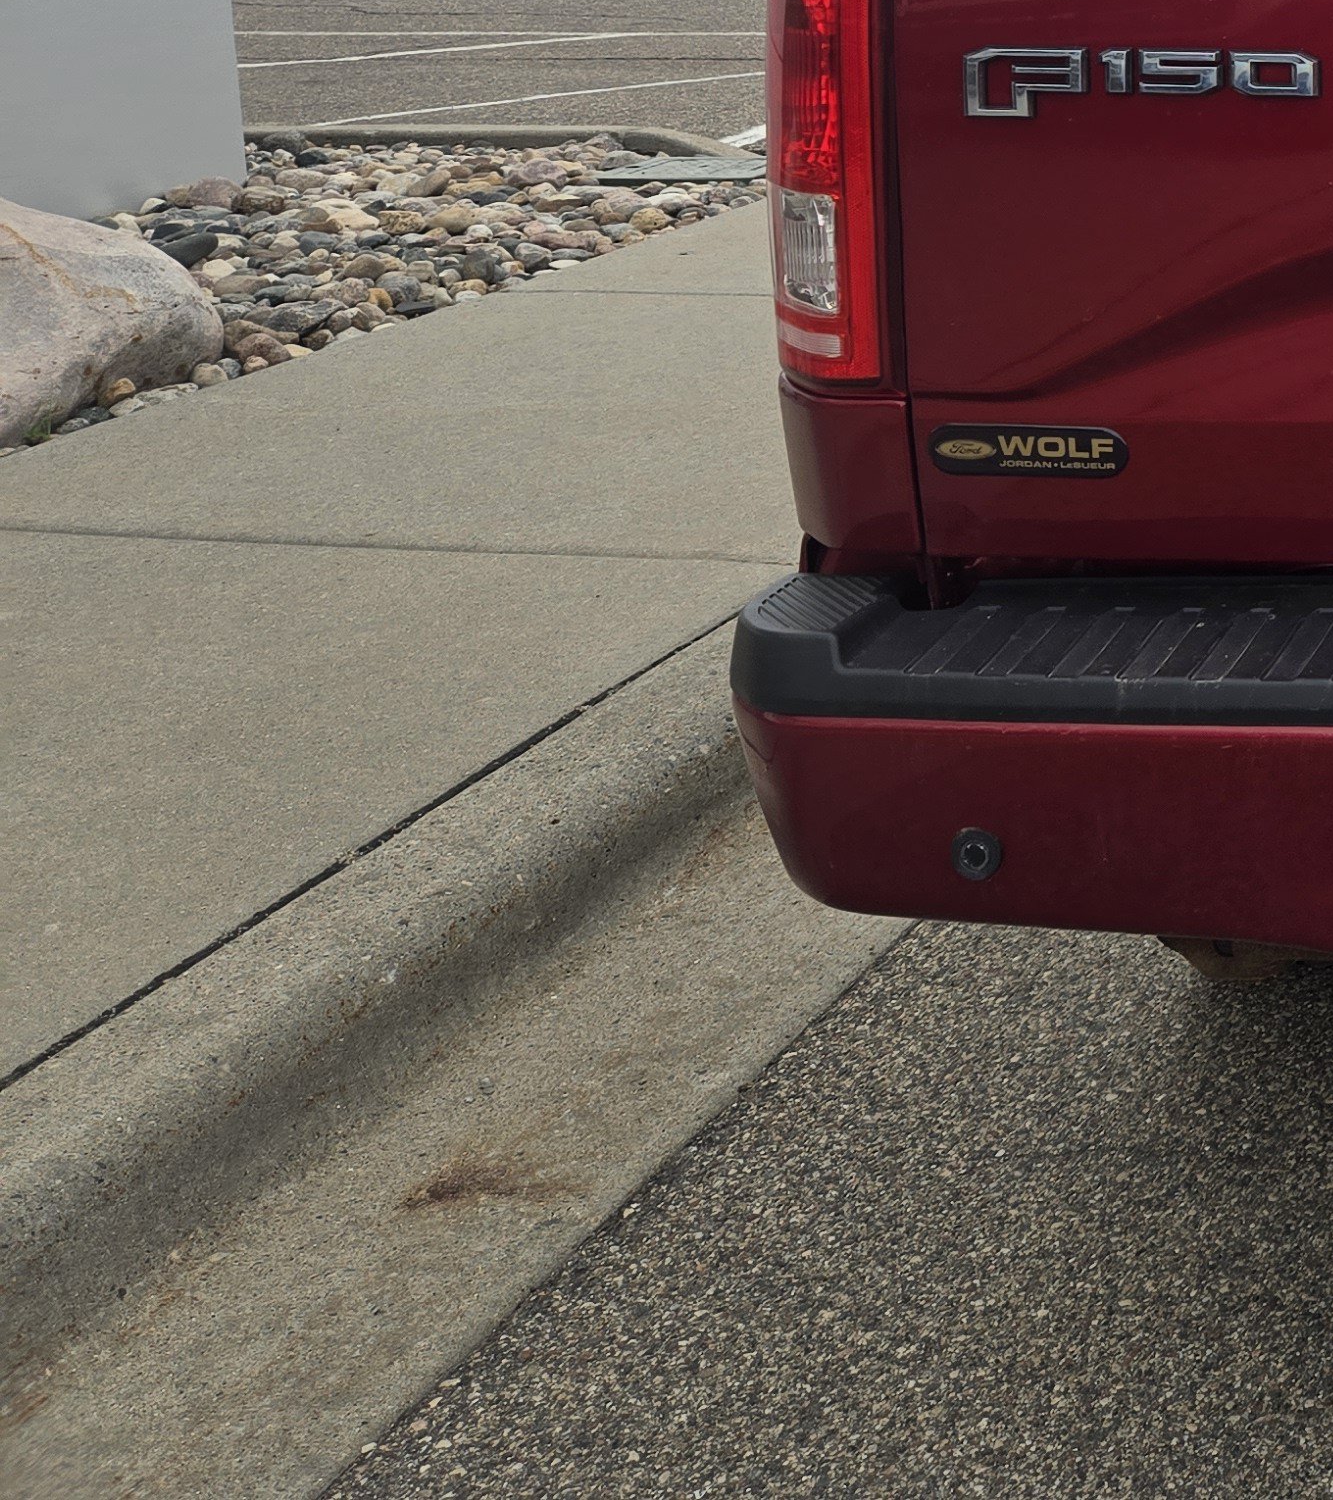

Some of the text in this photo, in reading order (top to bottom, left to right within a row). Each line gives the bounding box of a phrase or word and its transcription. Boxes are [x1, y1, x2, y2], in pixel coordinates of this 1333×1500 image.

[949, 441, 983, 455] Ford
[997, 435, 1114, 459] WOLF
[999, 460, 1116, 470] JORDAN LeSUEUR
